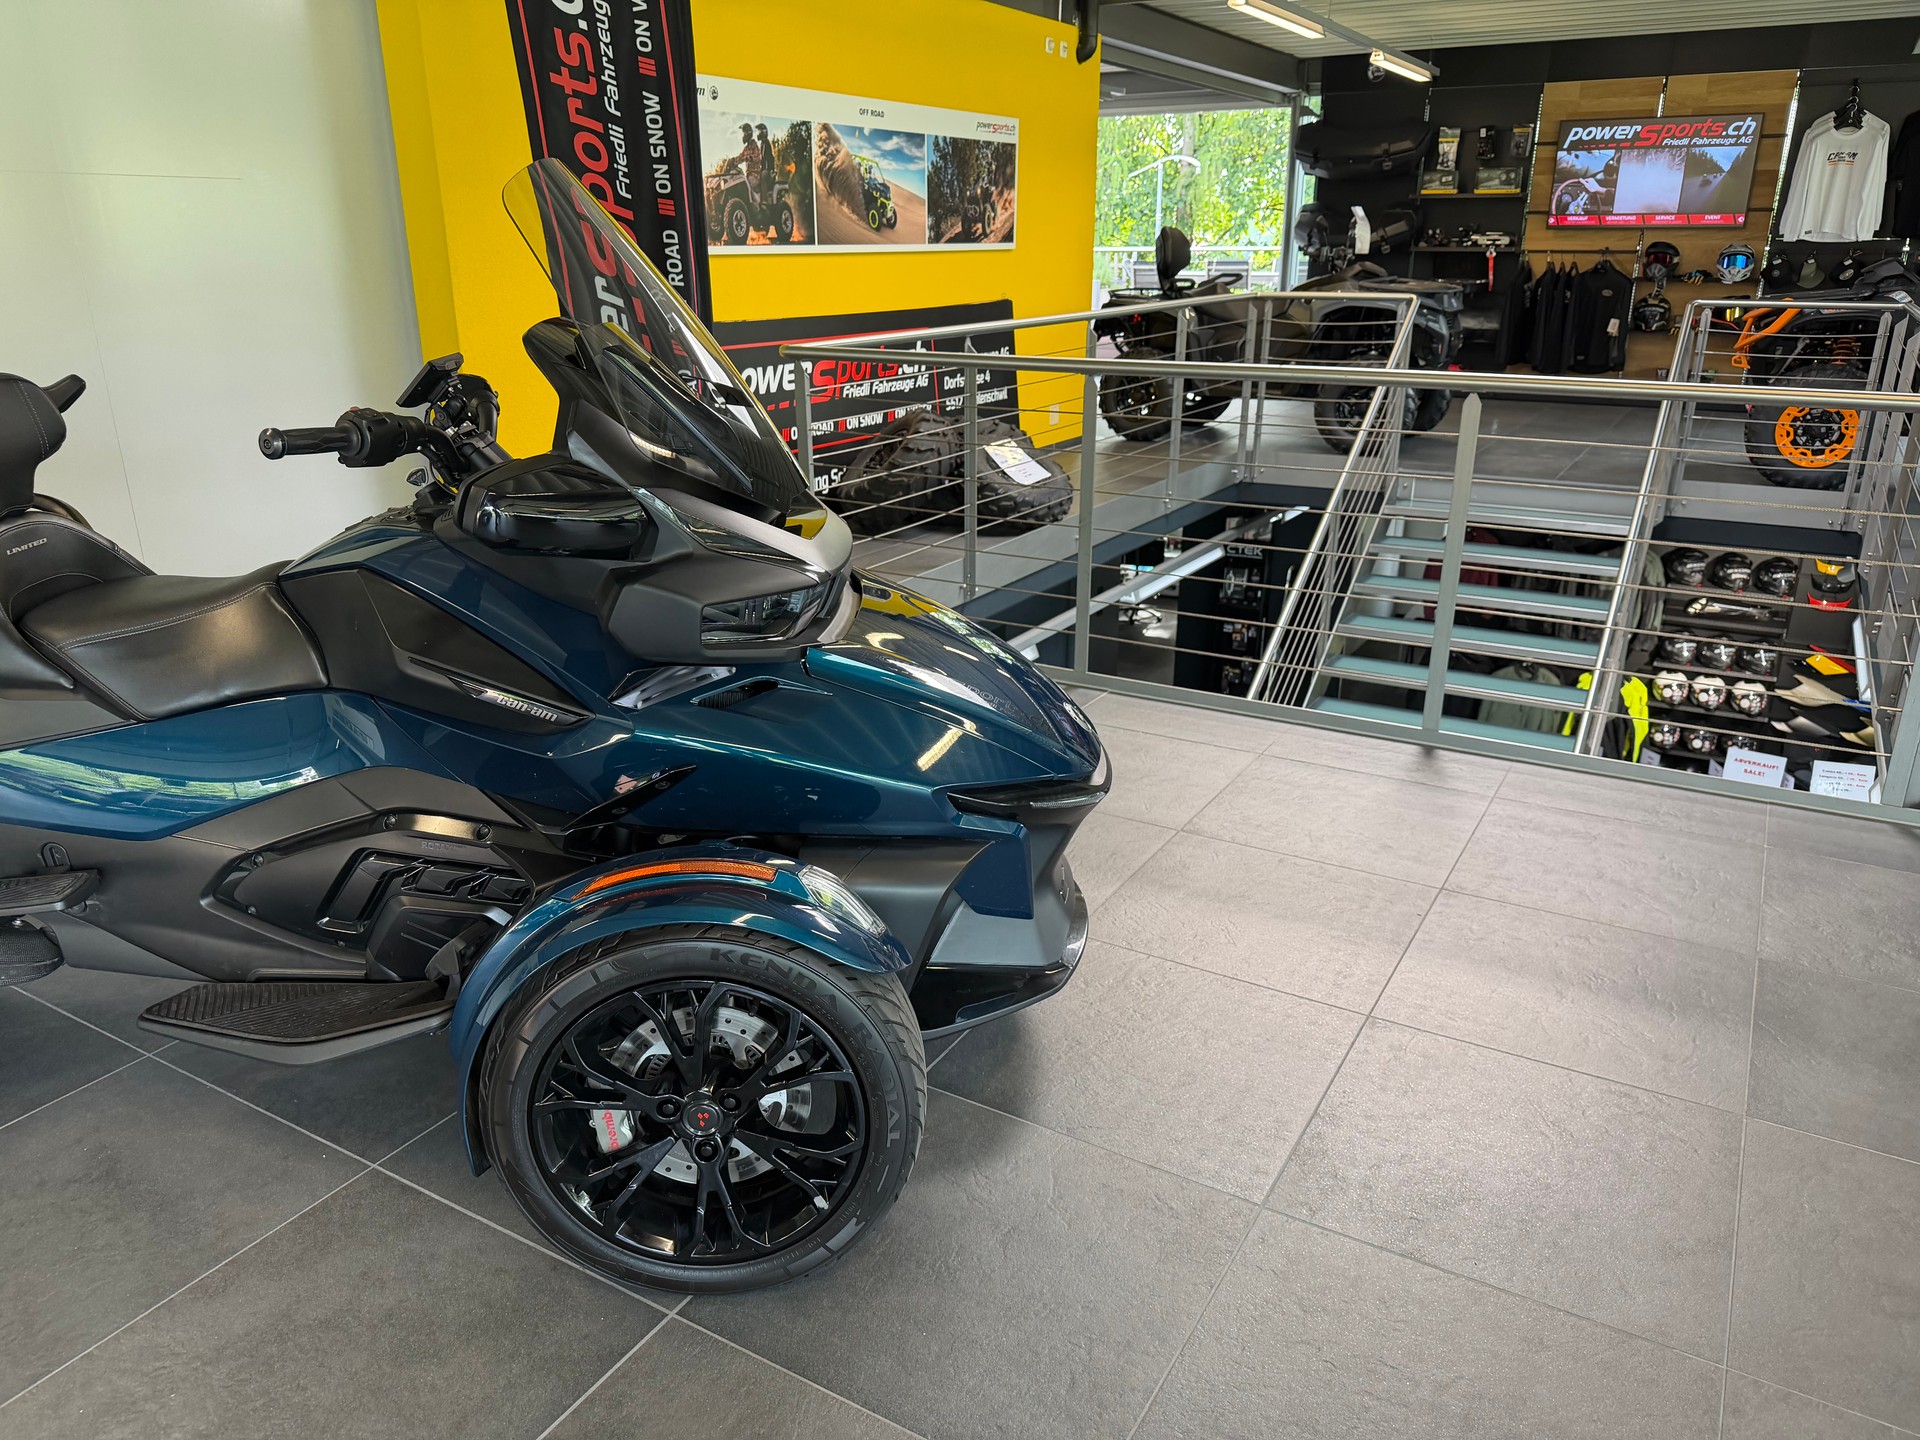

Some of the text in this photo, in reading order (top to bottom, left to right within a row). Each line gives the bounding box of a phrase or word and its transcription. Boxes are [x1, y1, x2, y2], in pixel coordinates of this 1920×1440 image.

[634, 19, 653, 53] ON
[593, 0, 633, 200] Friedli Fahrzeug
[858, 107, 885, 118] OFF ROAD
[642, 91, 673, 195] ON SNOW
[1662, 135, 1754, 147] Friedli Fahrzeuge AG
[842, 375, 929, 398] Friedli Fahrzeuge AG
[985, 369, 991, 383] 4
[847, 411, 884, 430] ON SNOW
[6, 537, 48, 556] LIMITED
[1226, 545, 1263, 556] CTEK
[496, 694, 558, 722] can-am
[709, 947, 840, 1013] KENDA
